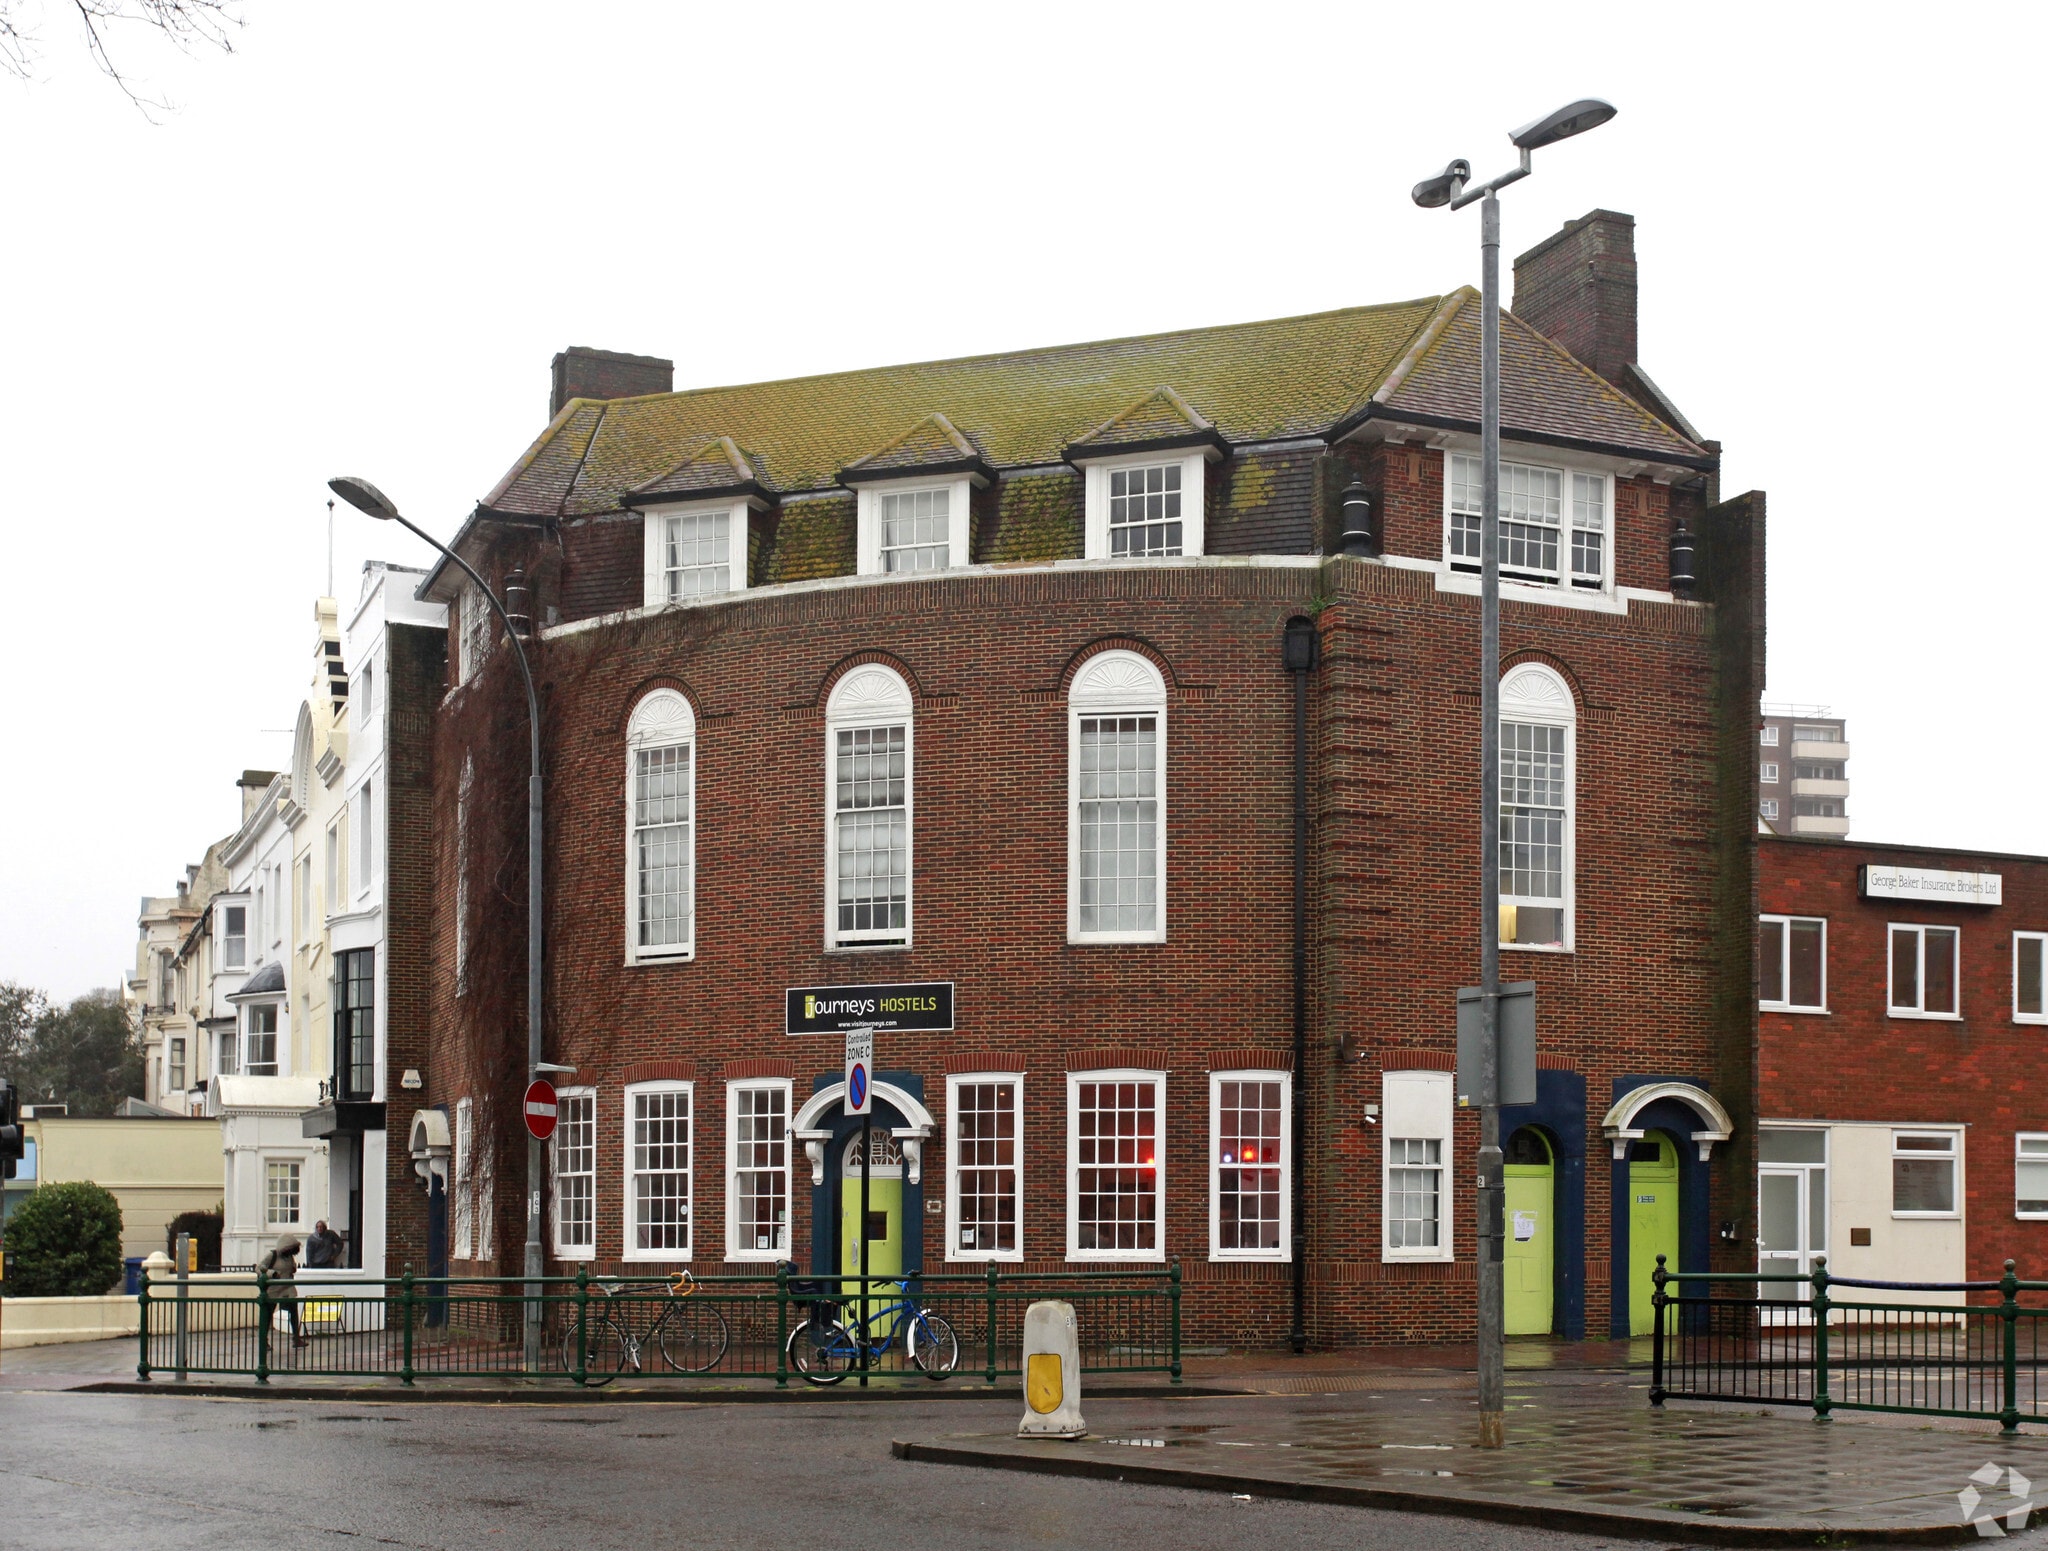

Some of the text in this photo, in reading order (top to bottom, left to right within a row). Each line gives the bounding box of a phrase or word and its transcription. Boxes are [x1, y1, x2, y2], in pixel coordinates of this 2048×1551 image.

[1871, 873, 1997, 895] George Baker Insurance Brokers Ltd
[805, 995, 937, 1018] journeys HOSTELS
[838, 1020, 898, 1028] www.visitjourneys.com
[848, 1032, 871, 1044] Controlled
[848, 1045, 870, 1060] ZONE C
[1478, 1177, 1482, 1186] 2
